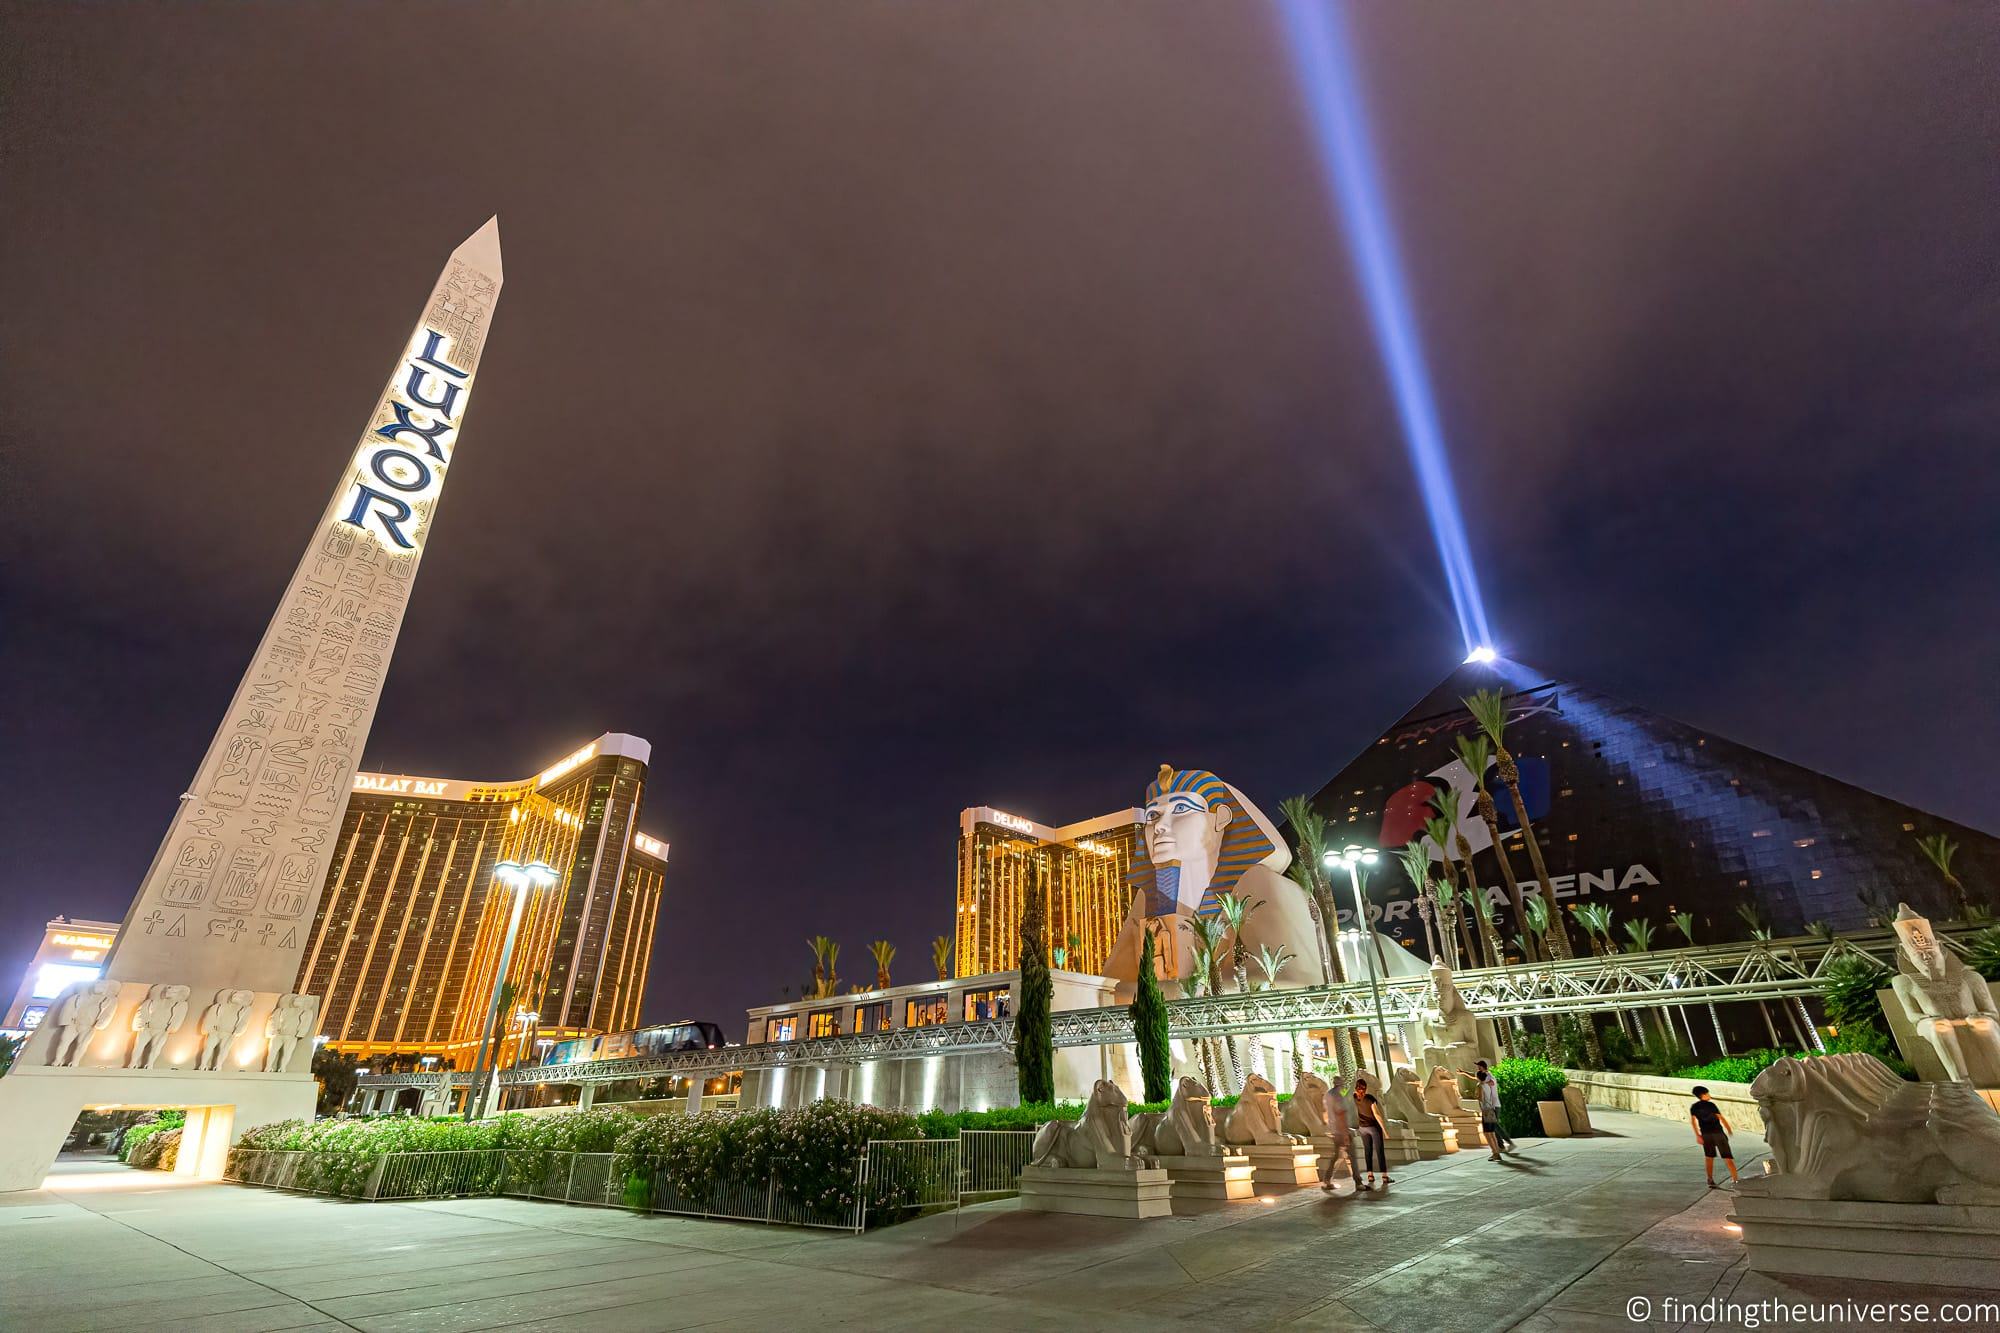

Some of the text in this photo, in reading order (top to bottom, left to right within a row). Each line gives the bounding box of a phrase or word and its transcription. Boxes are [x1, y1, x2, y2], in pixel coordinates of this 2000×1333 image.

[342, 327, 470, 548] LUXOR
[413, 780, 448, 796] BAY
[993, 811, 1034, 835] DELANO
[1484, 863, 1661, 907] ARENA
